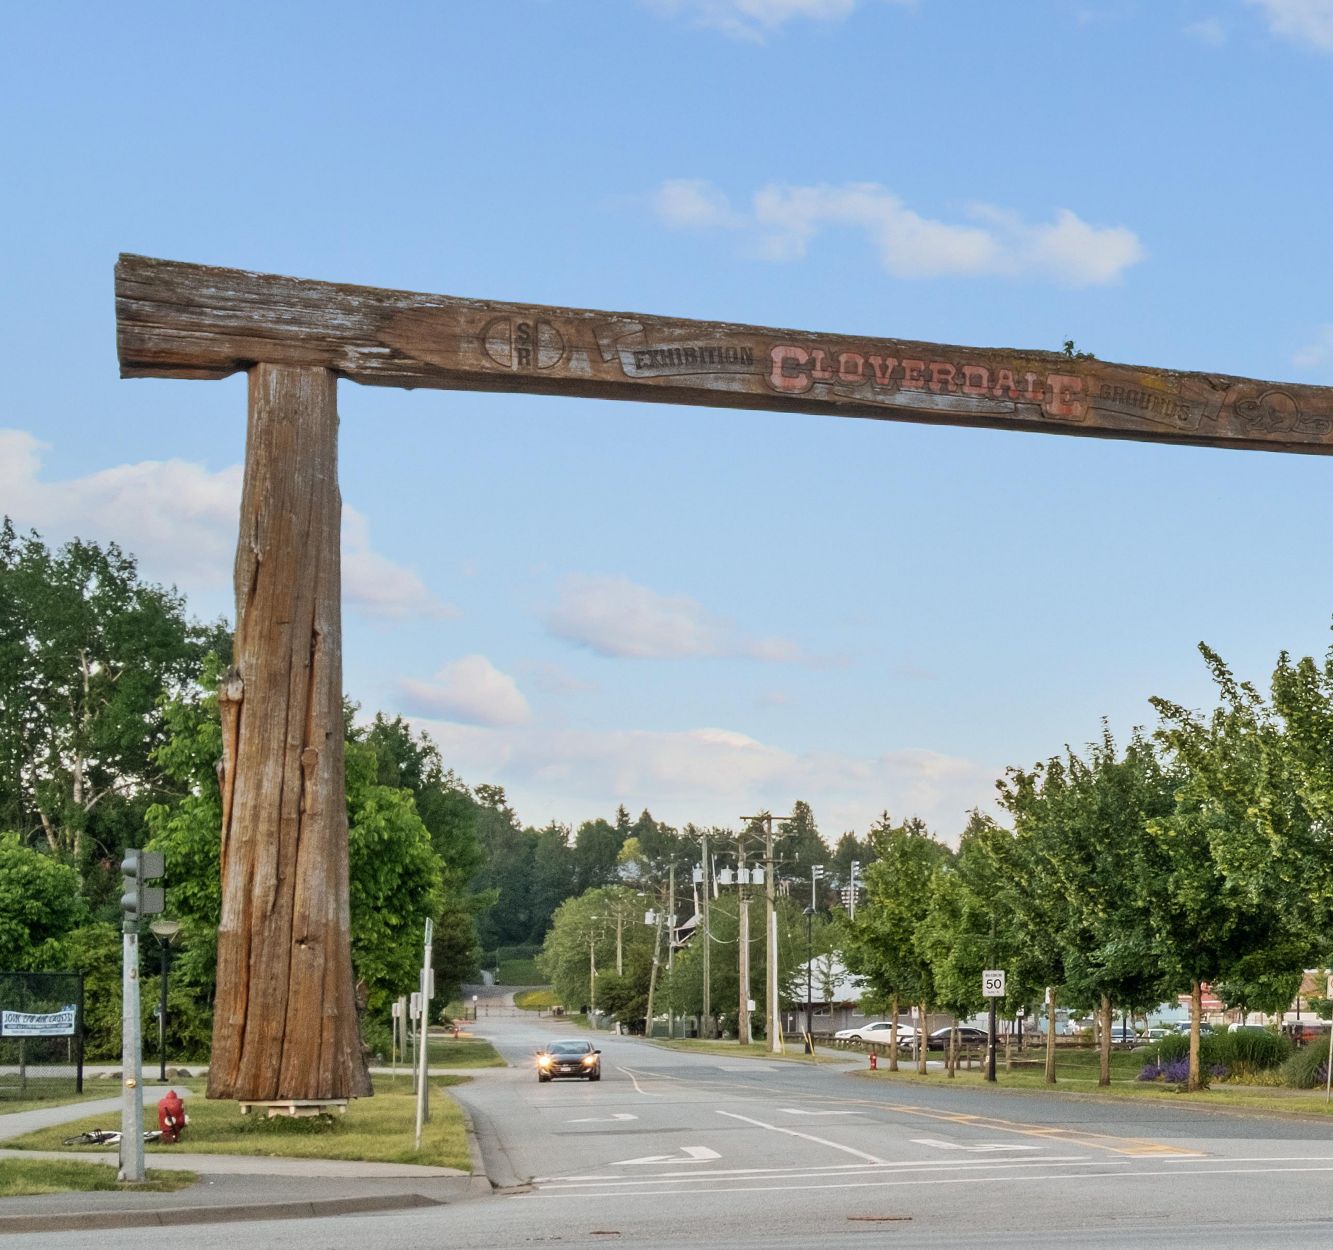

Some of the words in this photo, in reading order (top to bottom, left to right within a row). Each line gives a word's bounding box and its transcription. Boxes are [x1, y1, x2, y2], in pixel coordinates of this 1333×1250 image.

[633, 345, 754, 370] EXHIBITION
[770, 346, 1084, 416] CLOVERDALE
[1099, 383, 1190, 421] GROUNDS
[986, 978, 1002, 990] 50
